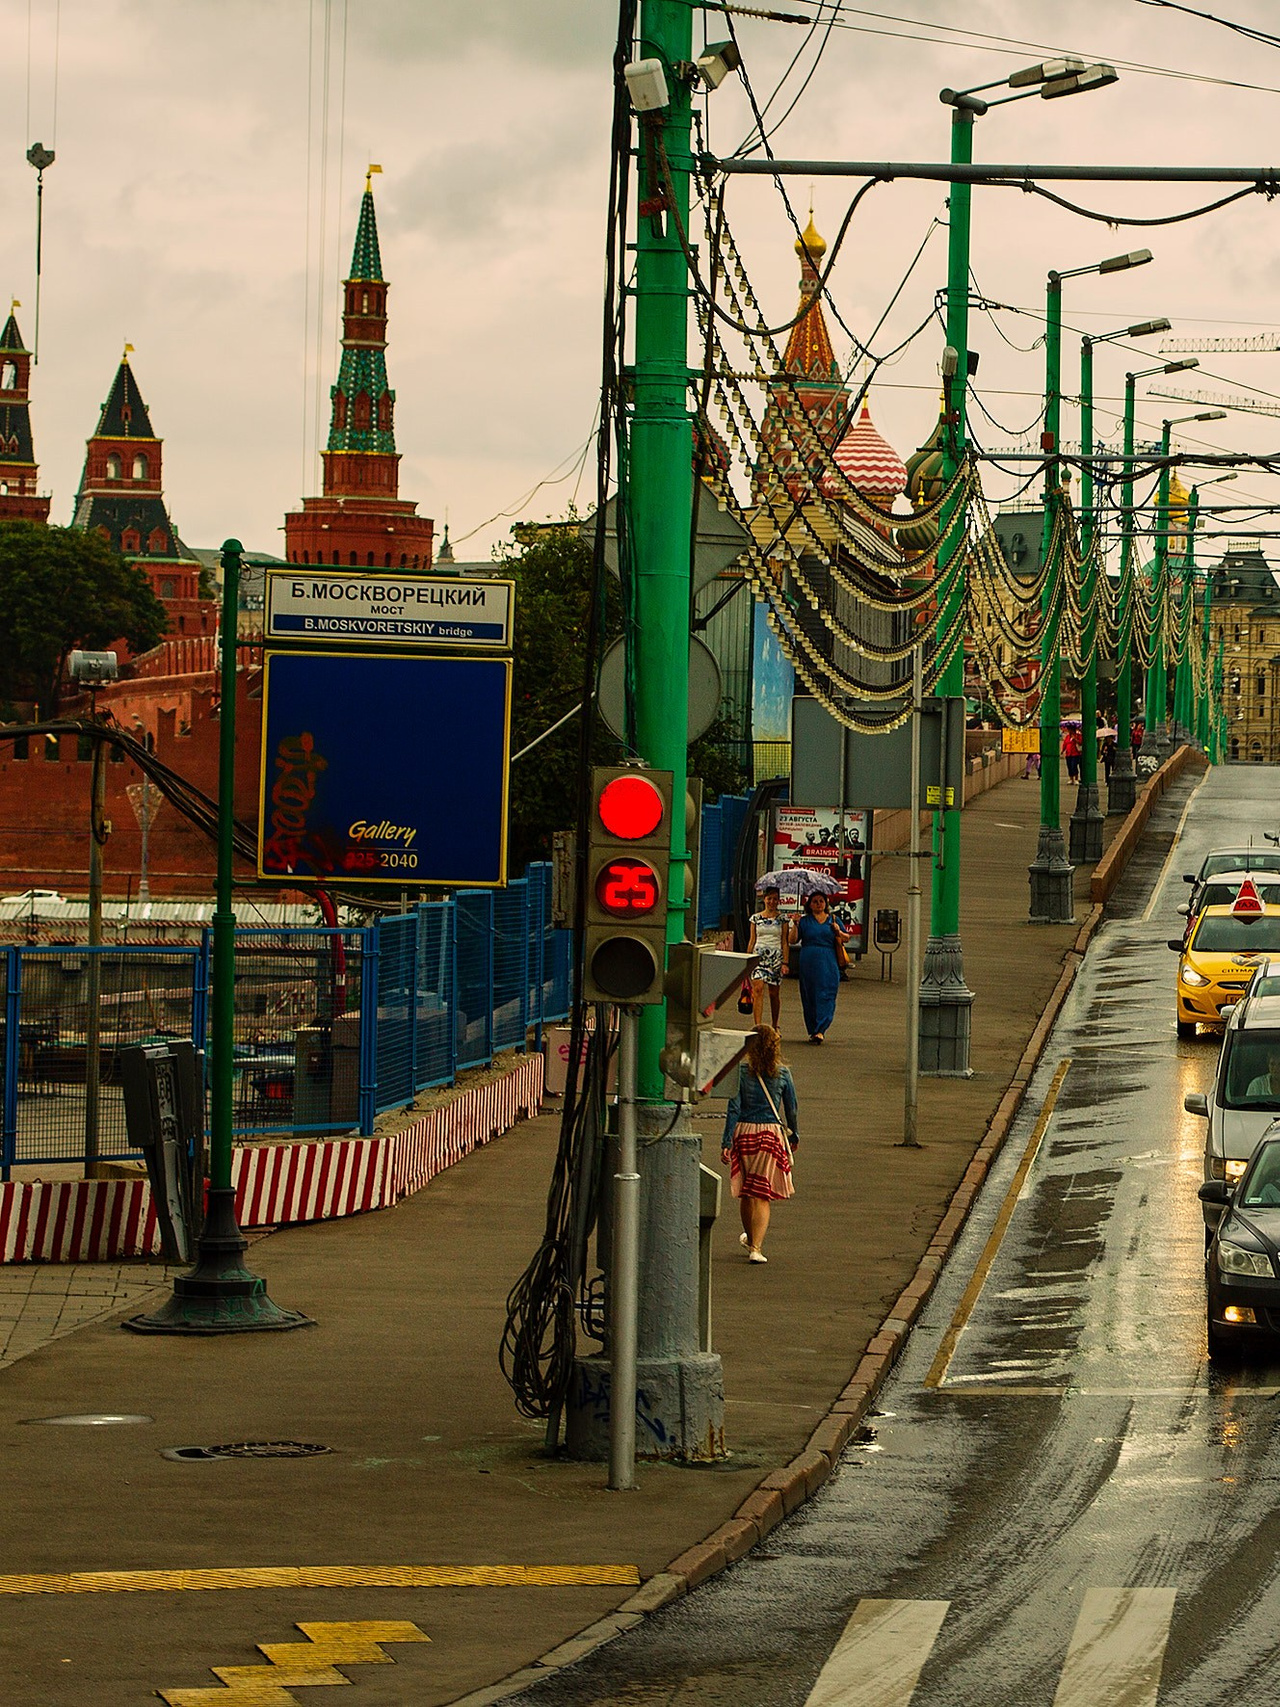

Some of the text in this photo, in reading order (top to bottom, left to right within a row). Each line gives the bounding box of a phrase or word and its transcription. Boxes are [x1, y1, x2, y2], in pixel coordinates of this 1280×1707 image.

[291, 582, 486, 608] Б.МОСКВОРЕЦКИЙ
[304, 618, 473, 638] B.MOSKVORETSKIY bridge
[789, 815, 818, 823] АВГУСТА
[348, 820, 417, 848] Gallery
[805, 848, 851, 857] BRAINSTO
